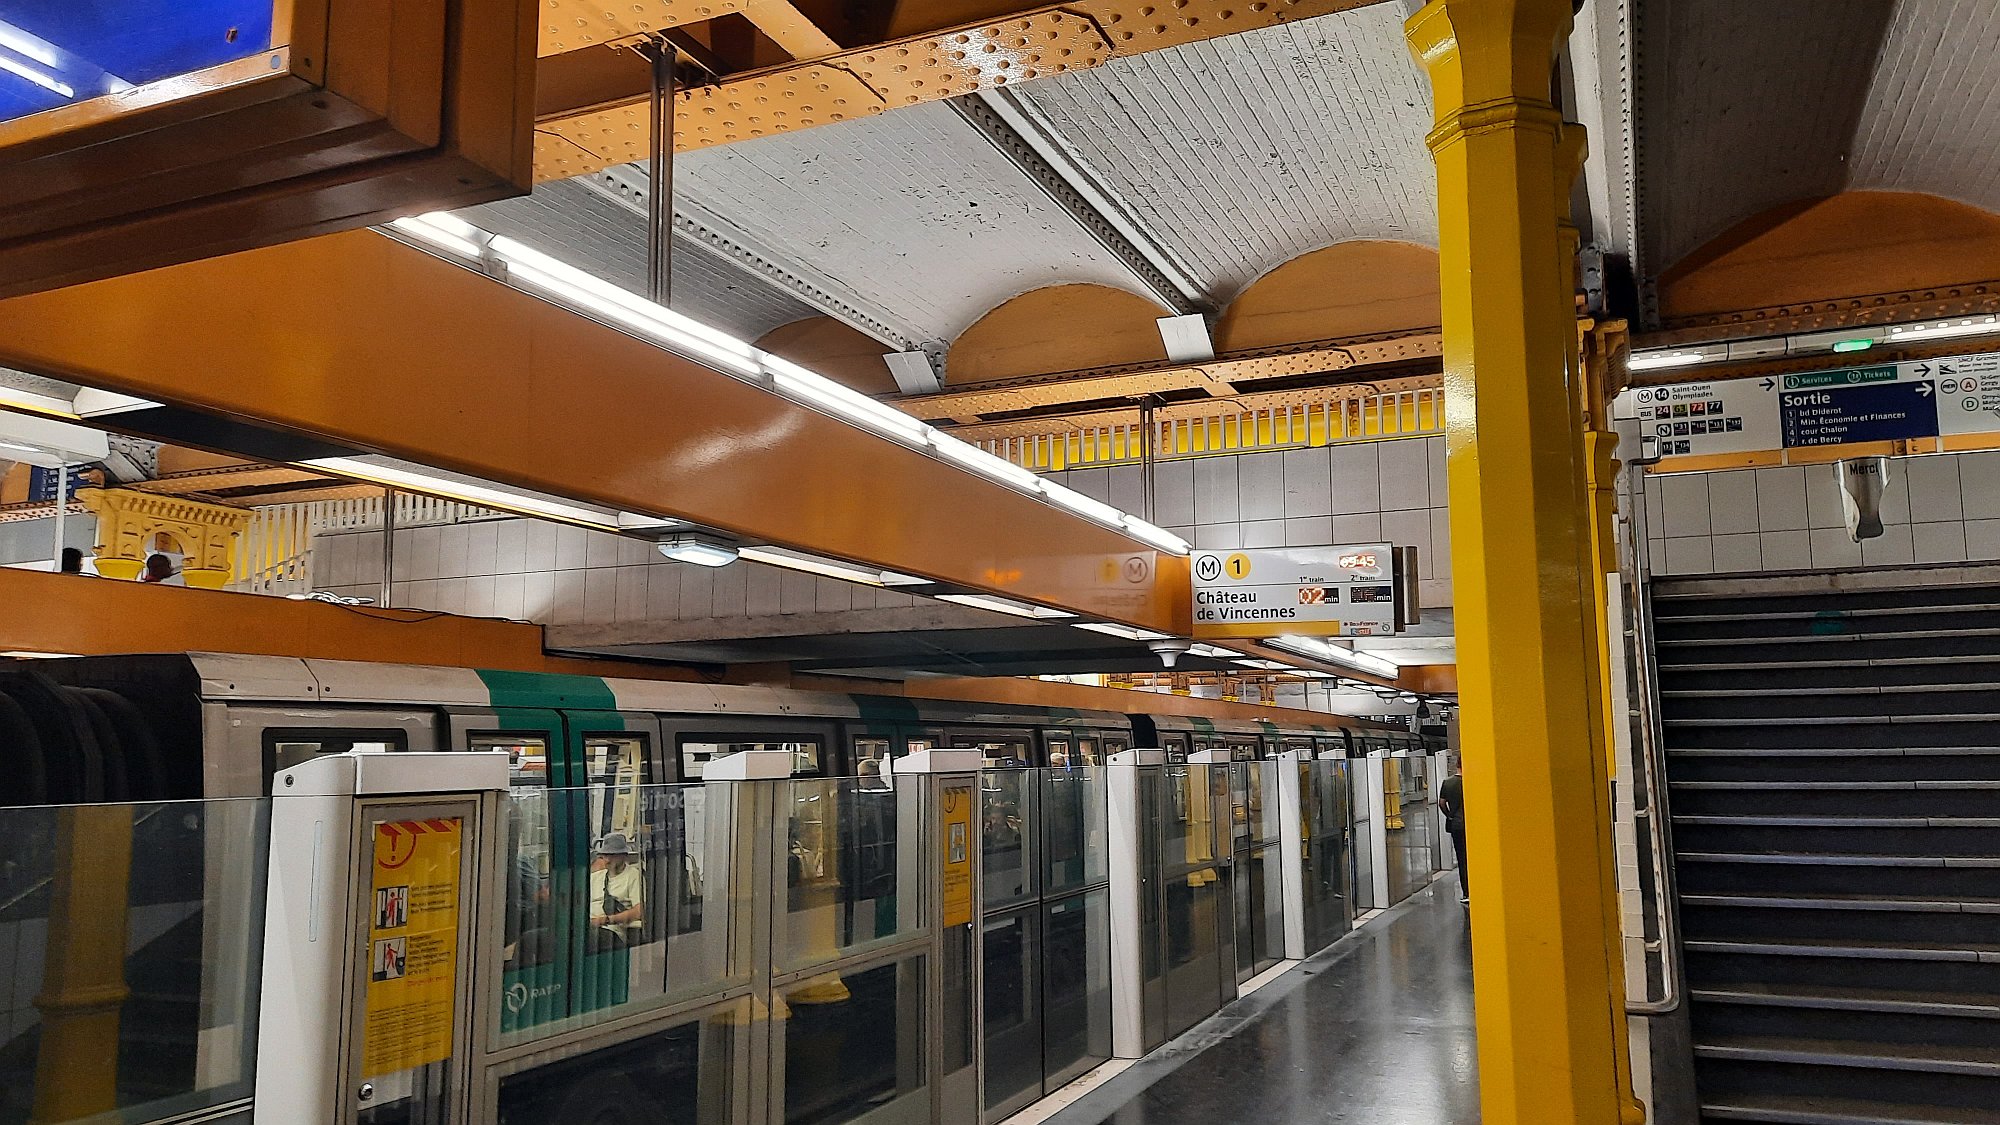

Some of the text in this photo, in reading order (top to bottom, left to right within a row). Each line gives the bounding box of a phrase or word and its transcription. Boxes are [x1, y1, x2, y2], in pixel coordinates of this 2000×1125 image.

[1863, 371, 1891, 379] Tickets
[1655, 390, 1668, 400] 14
[1671, 384, 1711, 394] Saint-Ouen
[1672, 391, 1713, 401] Olympiades
[1784, 391, 1831, 407] Sortie
[1656, 406, 1670, 415] 24
[1674, 404, 1687, 413] 63
[1691, 402, 1704, 412] 72
[1708, 401, 1721, 410] 77
[1812, 407, 1842, 416] Diderot
[1820, 416, 1858, 425] Économie
[1870, 411, 1906, 421] Finances
[1801, 428, 1818, 436] cour
[1820, 426, 1848, 434] Chalon
[1820, 436, 1842, 444] Bercy
[1196, 590, 1257, 605] Château
[1299, 587, 1325, 604] 02
[1196, 606, 1296, 620] de Vincennes
[530, 984, 562, 999] RATP
